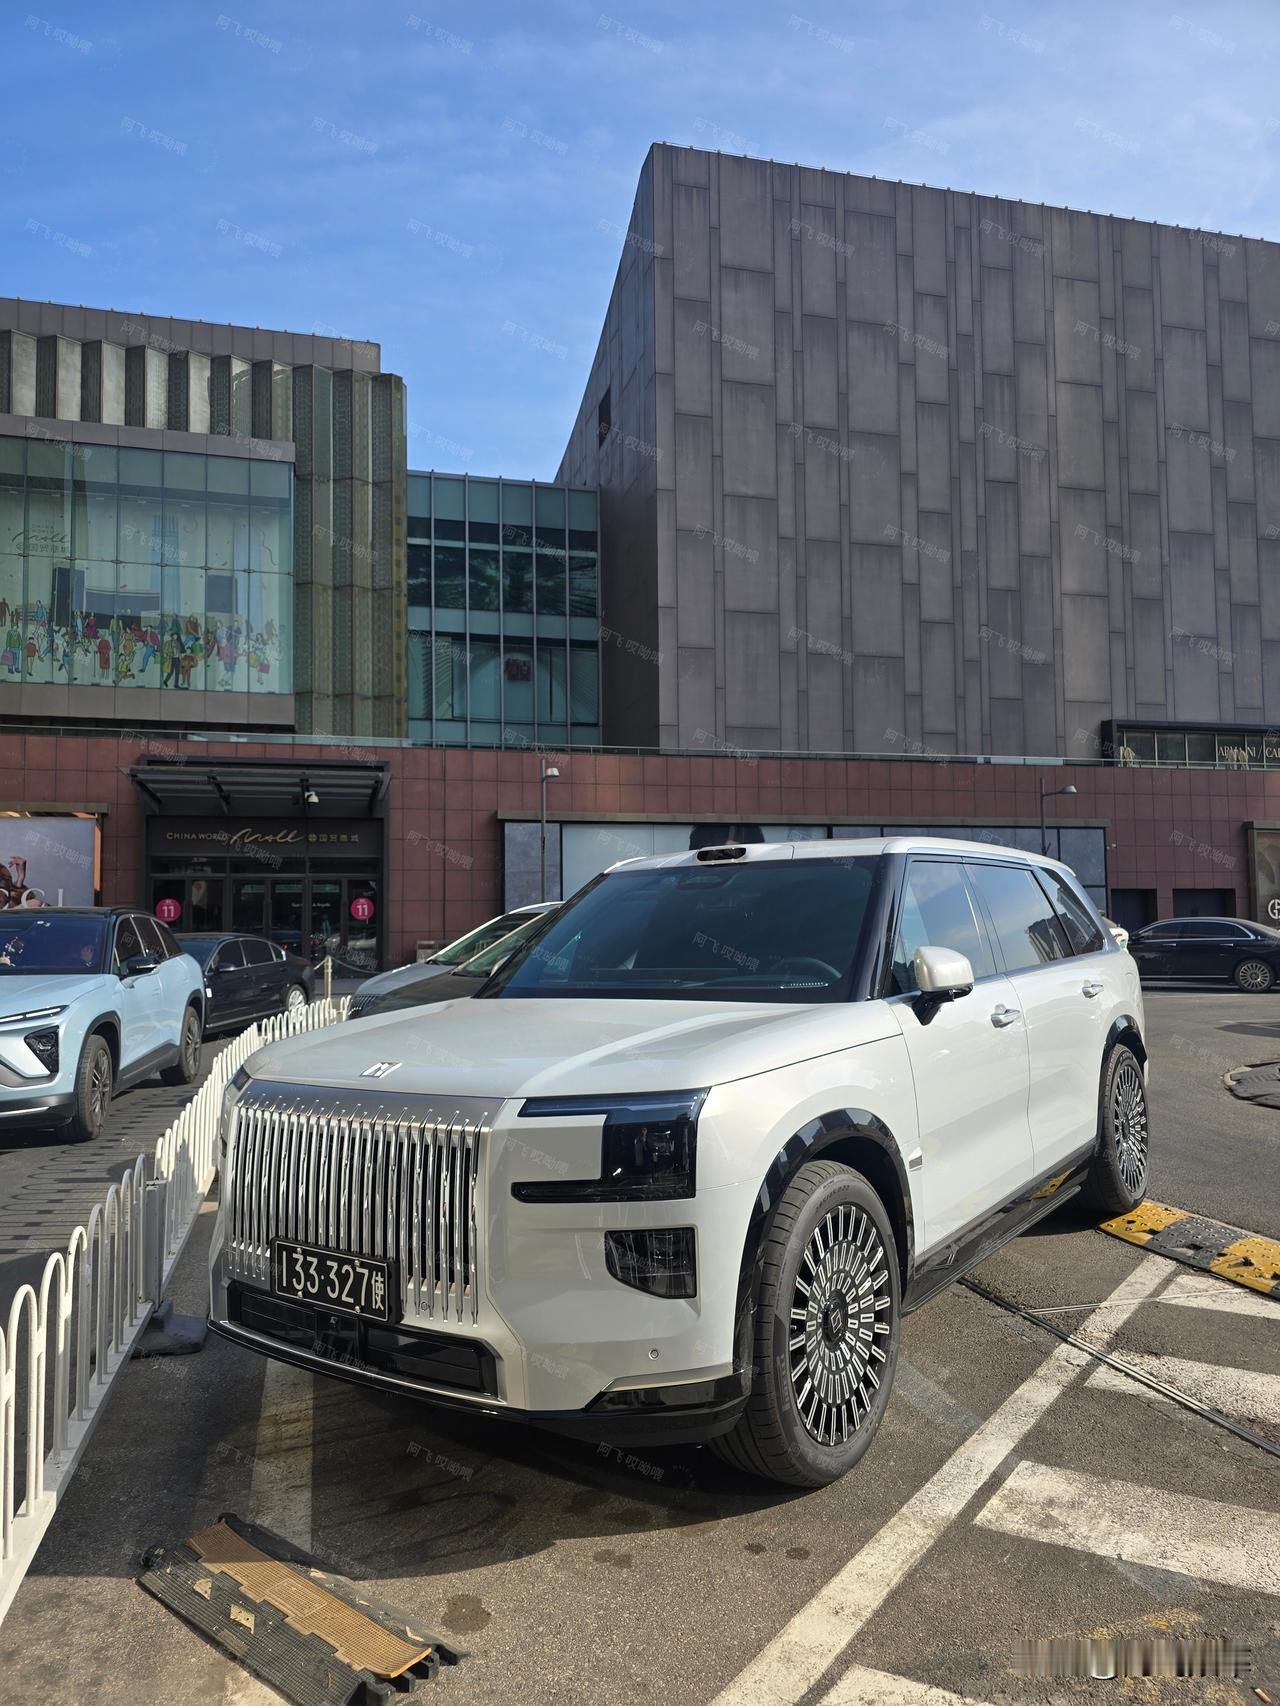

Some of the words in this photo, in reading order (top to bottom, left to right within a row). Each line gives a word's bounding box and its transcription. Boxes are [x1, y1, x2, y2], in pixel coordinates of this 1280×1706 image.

[166, 832, 197, 840] CHINA
[162, 906, 174, 918] 11
[357, 904, 368, 916] 11
